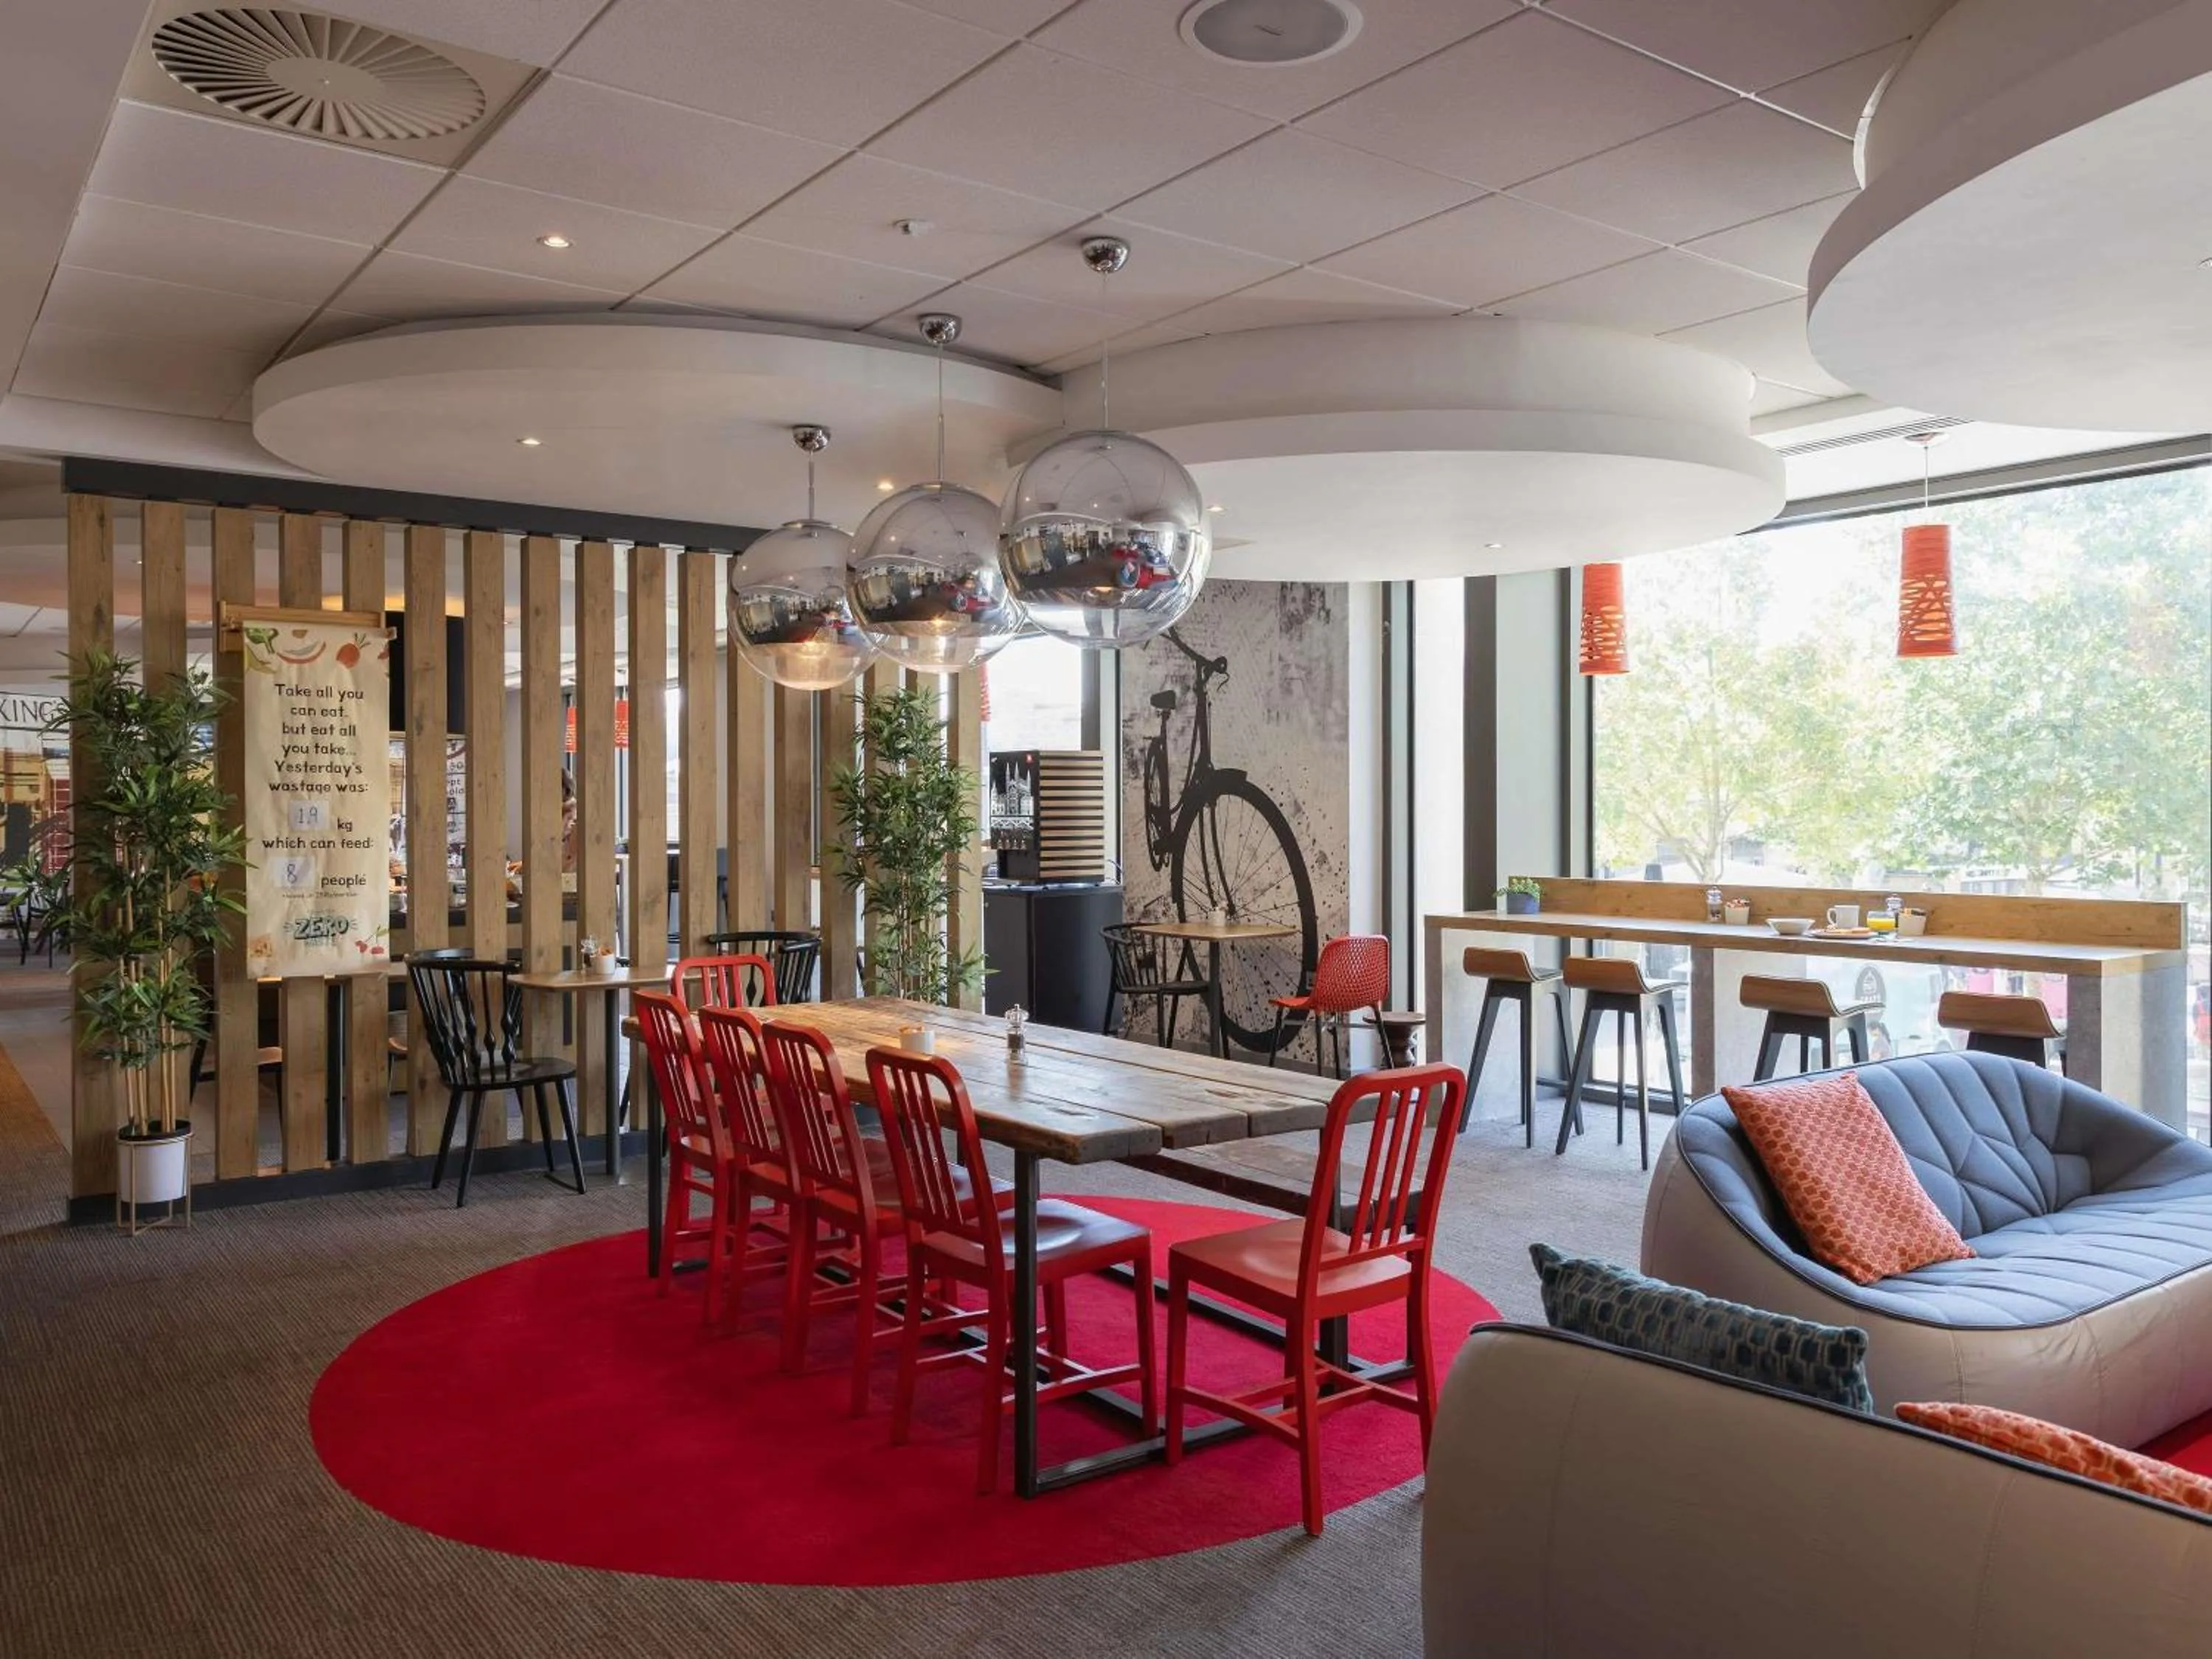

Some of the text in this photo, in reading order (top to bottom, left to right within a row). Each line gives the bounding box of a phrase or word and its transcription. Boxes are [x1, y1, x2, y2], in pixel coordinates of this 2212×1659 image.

[274, 684, 364, 703] Take all you
[291, 706, 316, 717] can
[282, 722, 356, 737] but eat all
[282, 742, 310, 758] you
[274, 759, 363, 778] Yesterday's
[335, 782, 369, 793] was:
[337, 818, 353, 832] kg
[262, 837, 374, 849] which can feed:
[287, 863, 298, 884] 8
[321, 874, 366, 889] people
[293, 915, 349, 940] ZERO
